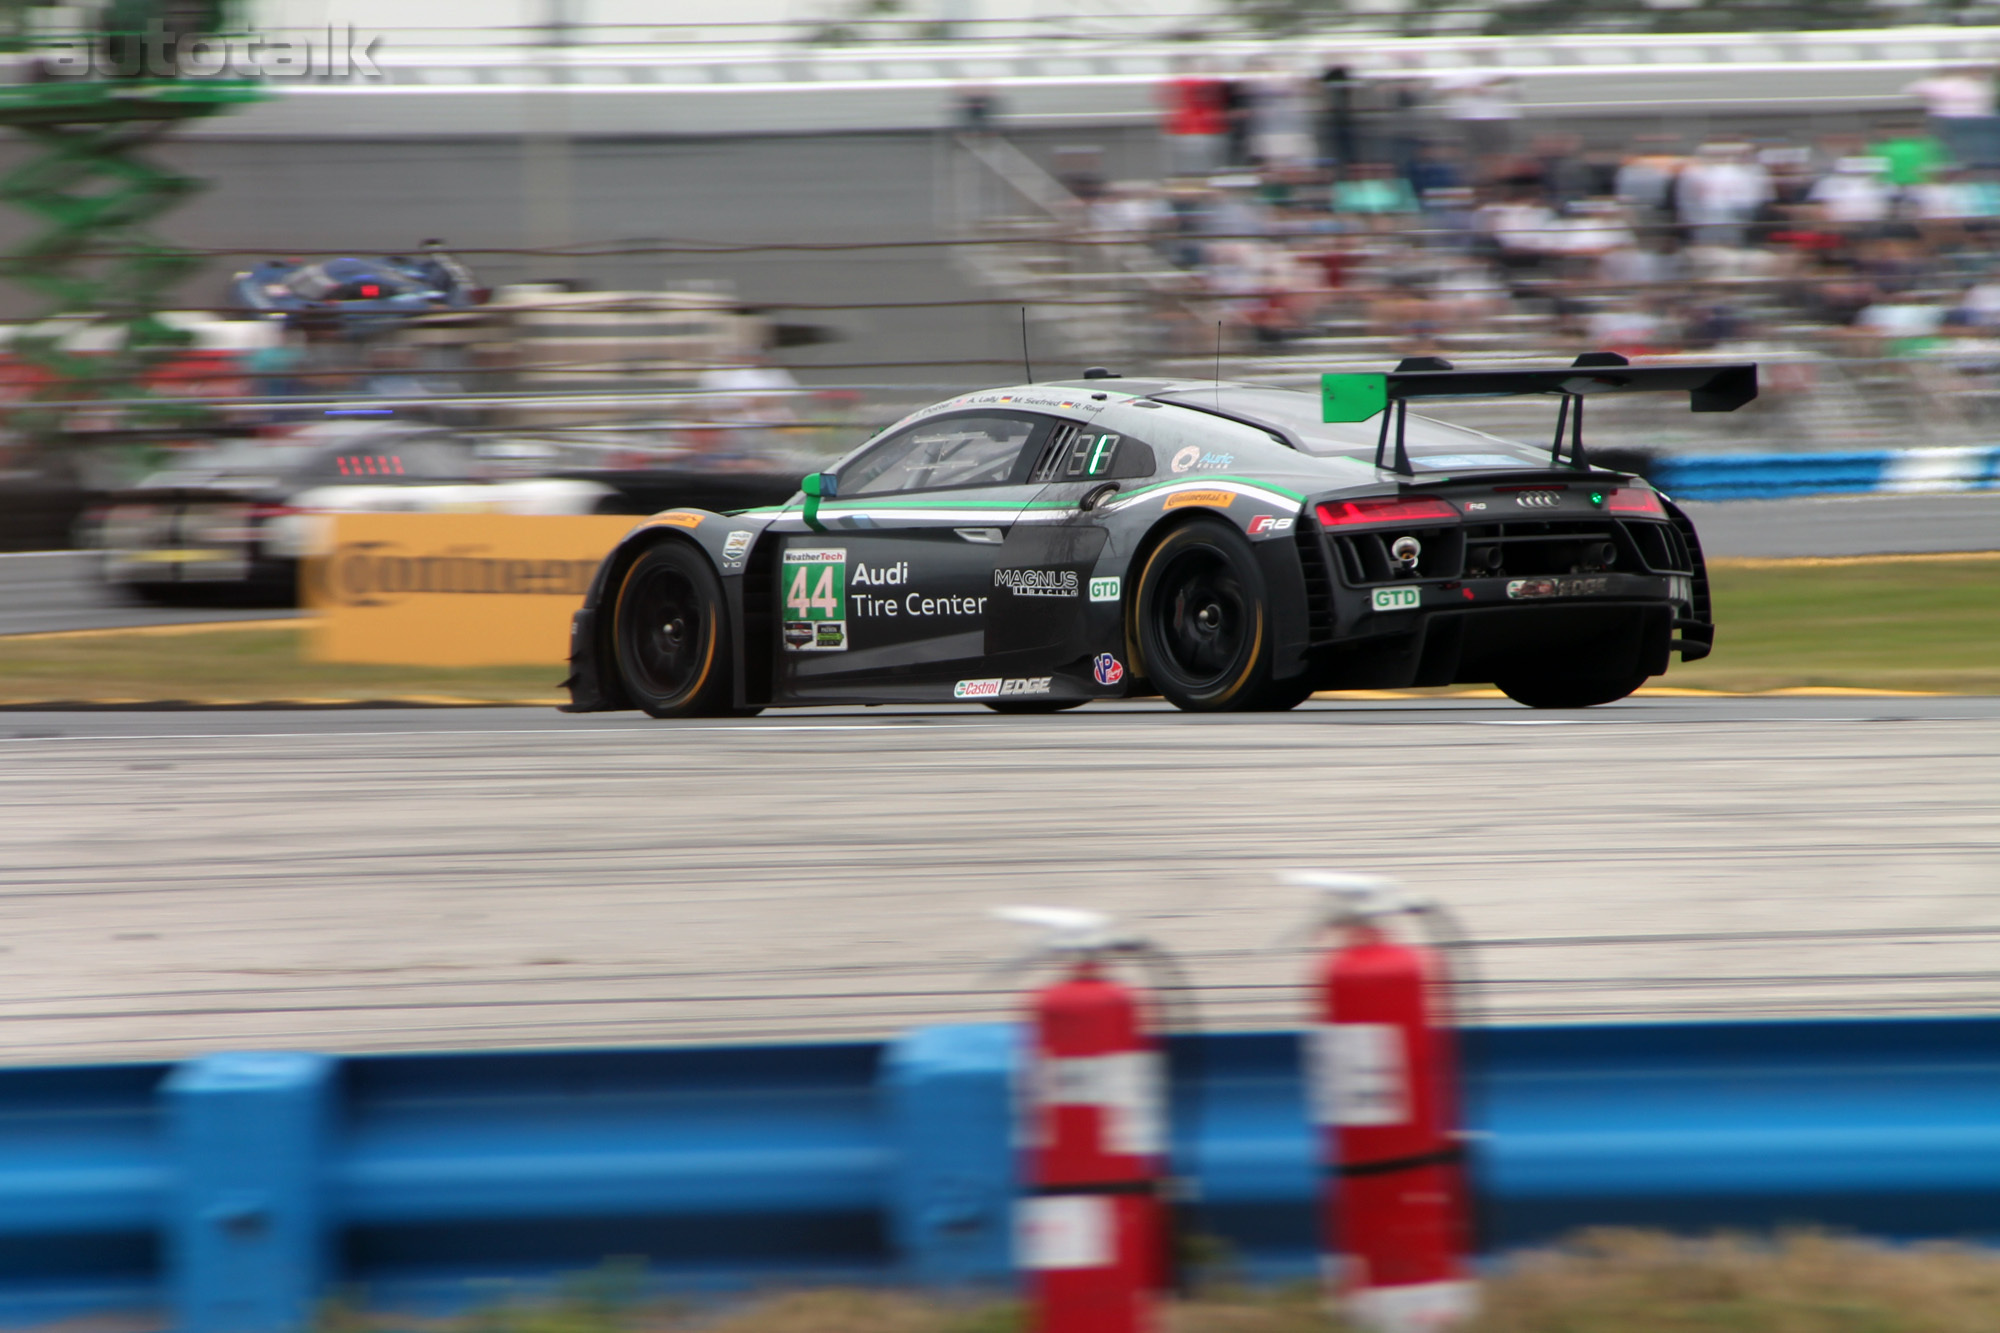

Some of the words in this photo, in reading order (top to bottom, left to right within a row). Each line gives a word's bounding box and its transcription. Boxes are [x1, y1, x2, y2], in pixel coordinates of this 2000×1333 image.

[1024, 397, 1061, 407] Seefried
[1200, 451, 1234, 464] Auric
[1254, 517, 1295, 532] R8
[785, 552, 843, 561] WeatherTech
[851, 562, 908, 586] Audi
[994, 569, 1079, 588] MAGNUS
[787, 565, 838, 618] 44
[1029, 588, 1077, 597] RACING
[1091, 580, 1119, 598] GTD
[1375, 589, 1417, 607] GTD
[851, 594, 898, 617] Tire
[905, 592, 988, 616] Center
[1094, 653, 1114, 683] VP
[965, 681, 999, 696] Castrol
[1000, 677, 1053, 695] EDGE
